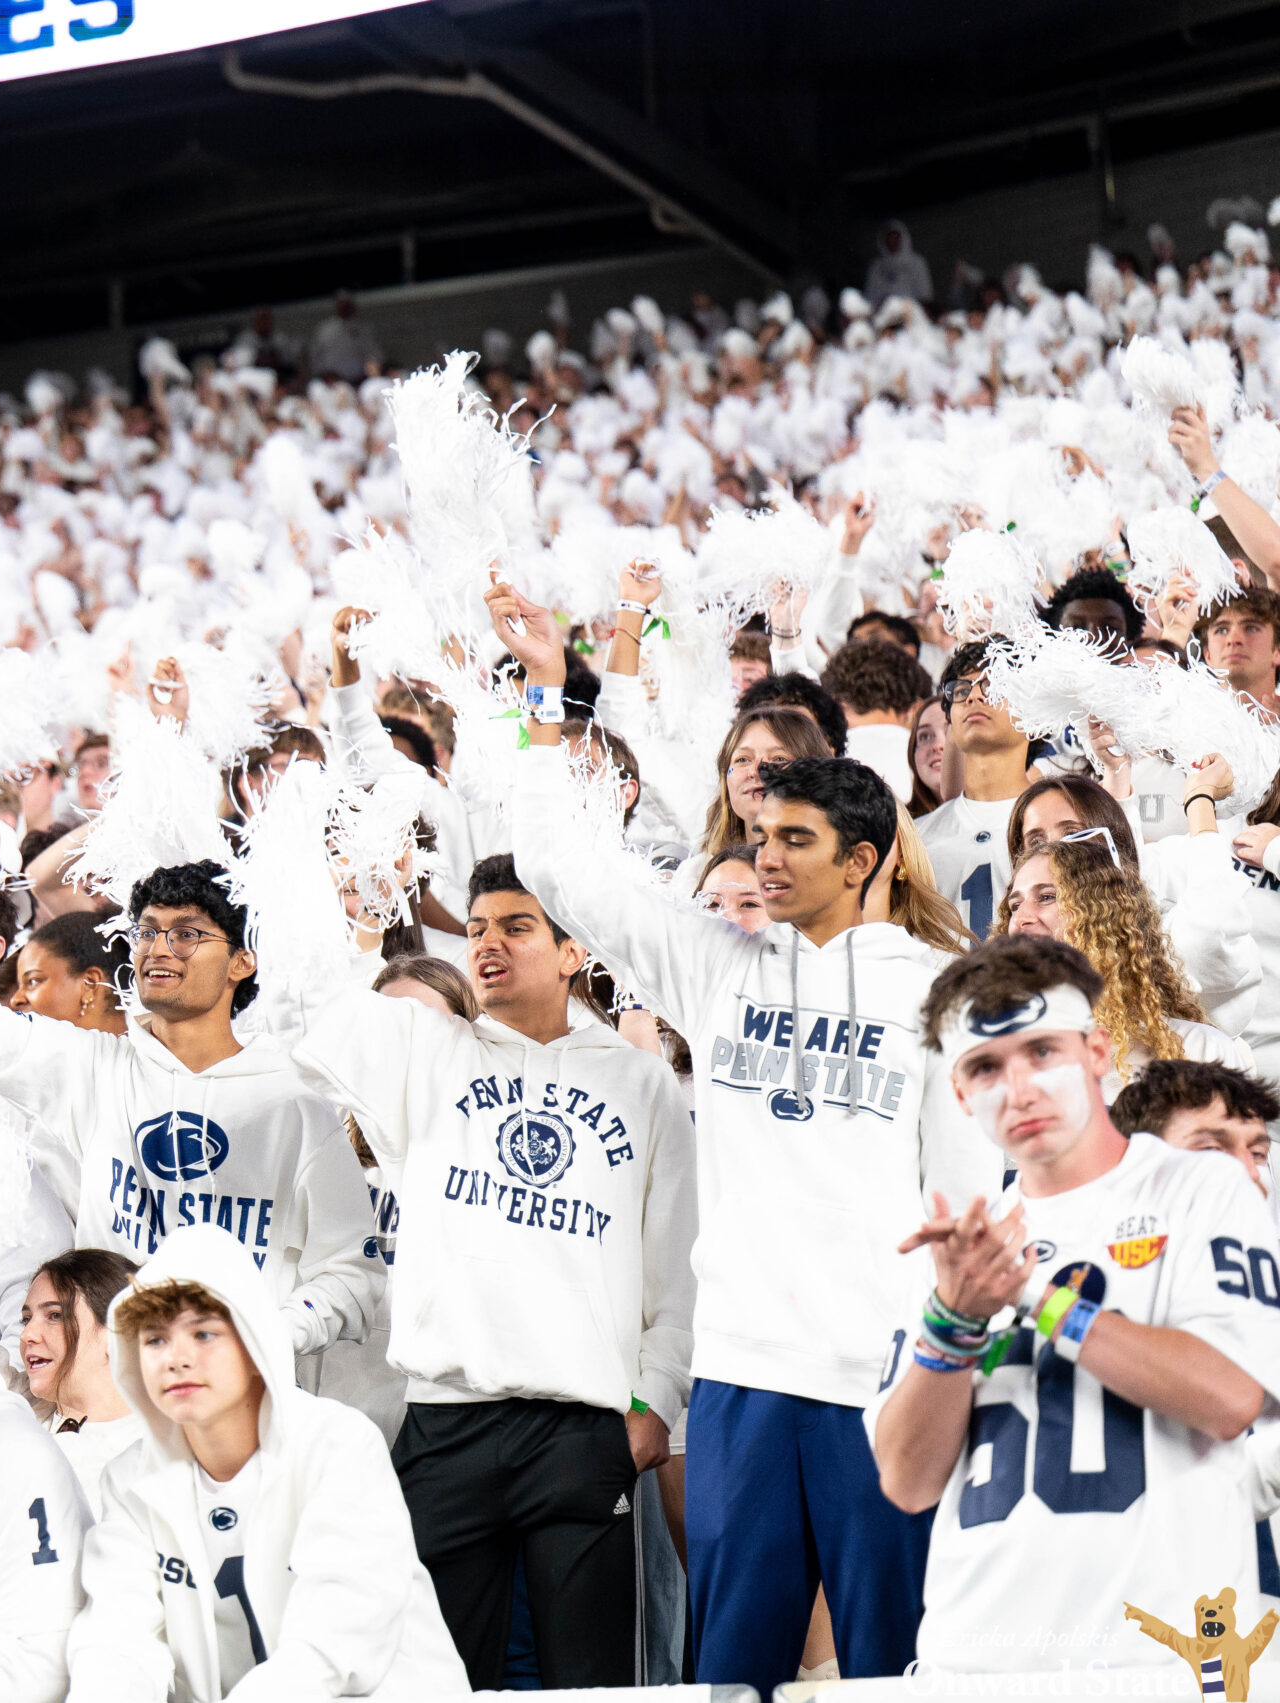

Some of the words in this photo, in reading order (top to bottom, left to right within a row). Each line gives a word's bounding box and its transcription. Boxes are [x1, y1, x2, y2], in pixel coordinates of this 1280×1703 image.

[743, 1004, 794, 1048] WE
[804, 1016, 885, 1060] ARE
[711, 1035, 790, 1085] PENN
[800, 1053, 907, 1112] STATE
[542, 1083, 634, 1168] STATE
[109, 1156, 166, 1237] PENN
[177, 1192, 274, 1247] STATE
[445, 1165, 612, 1246] UNIVERSITY
[1115, 1215, 1158, 1239] BEAT
[1113, 1235, 1160, 1268] USC
[1210, 1236, 1280, 1309] 50
[28, 1497, 59, 1566] 1
[213, 1554, 269, 1666] 1
